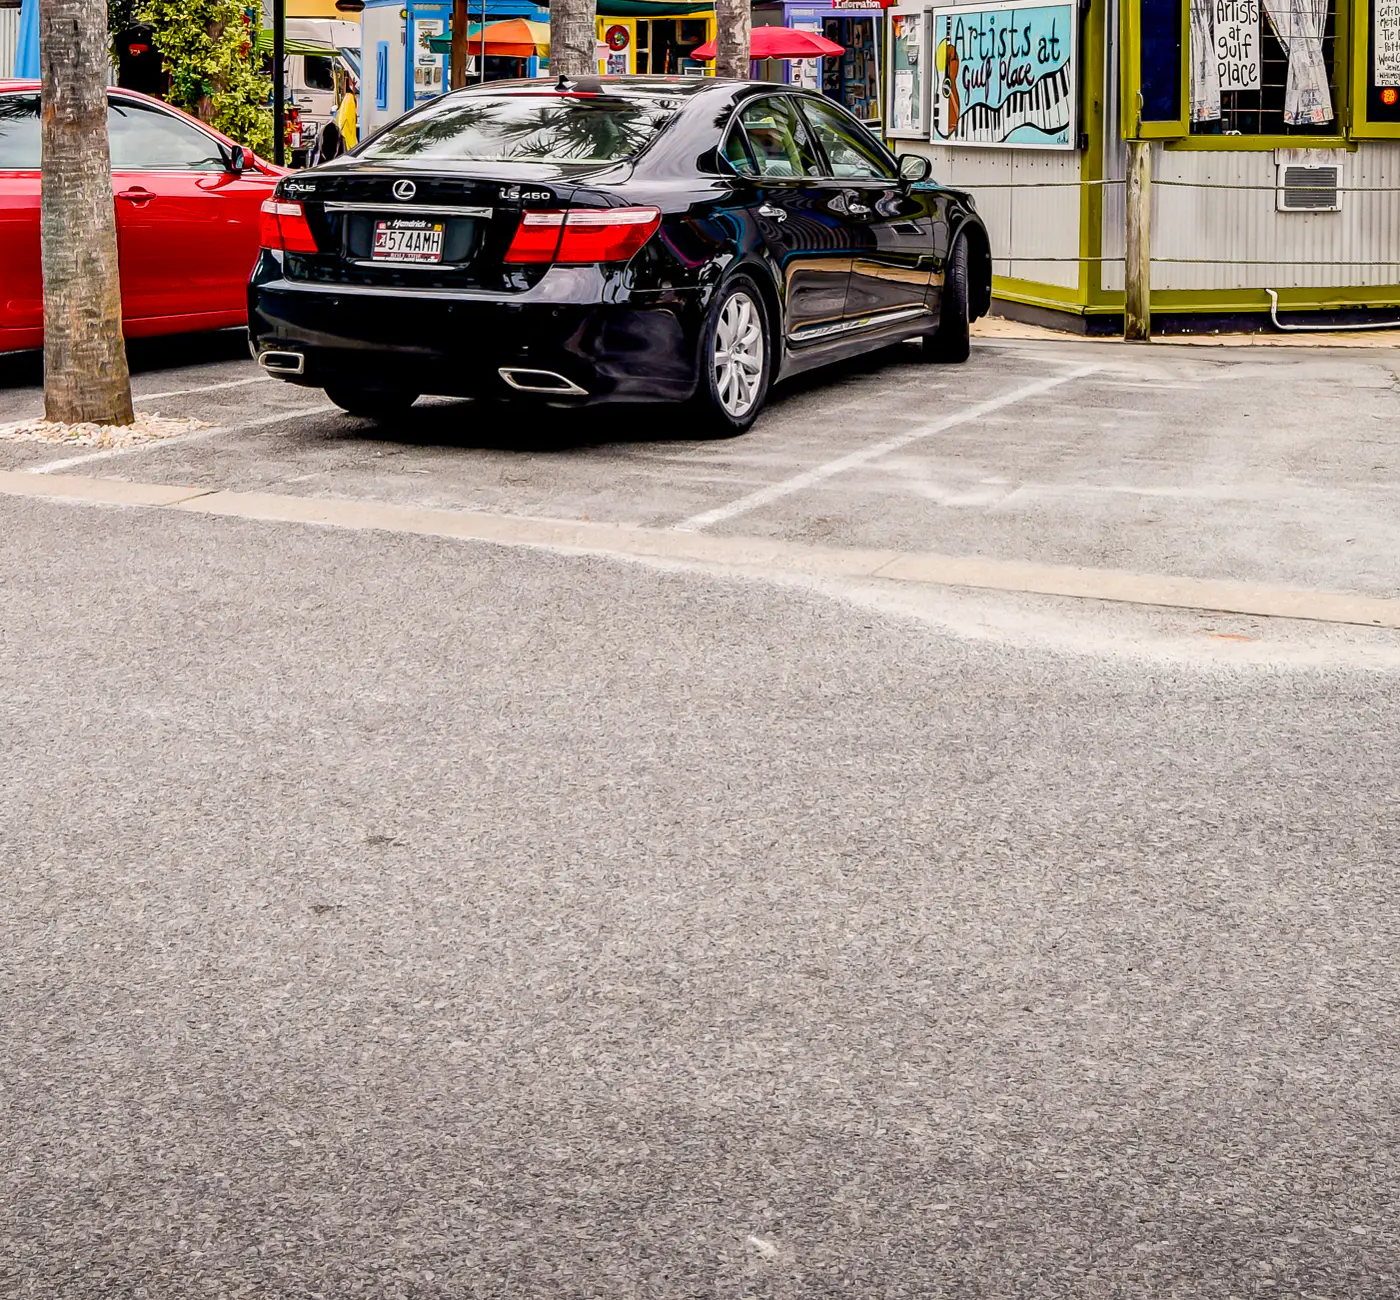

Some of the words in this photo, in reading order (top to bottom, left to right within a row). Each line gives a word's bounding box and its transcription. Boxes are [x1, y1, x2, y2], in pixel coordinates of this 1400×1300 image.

[834, 0, 881, 9] Information
[952, 10, 1032, 62] Artists
[1037, 17, 1060, 64] at
[1229, 25, 1241, 41] at
[1218, 33, 1252, 61] gulf
[1384, 41, 1400, 52] Pott
[284, 183, 316, 192] LEXUS
[501, 191, 520, 199] LS
[521, 192, 551, 200] 460
[387, 231, 441, 252] 574AMH
